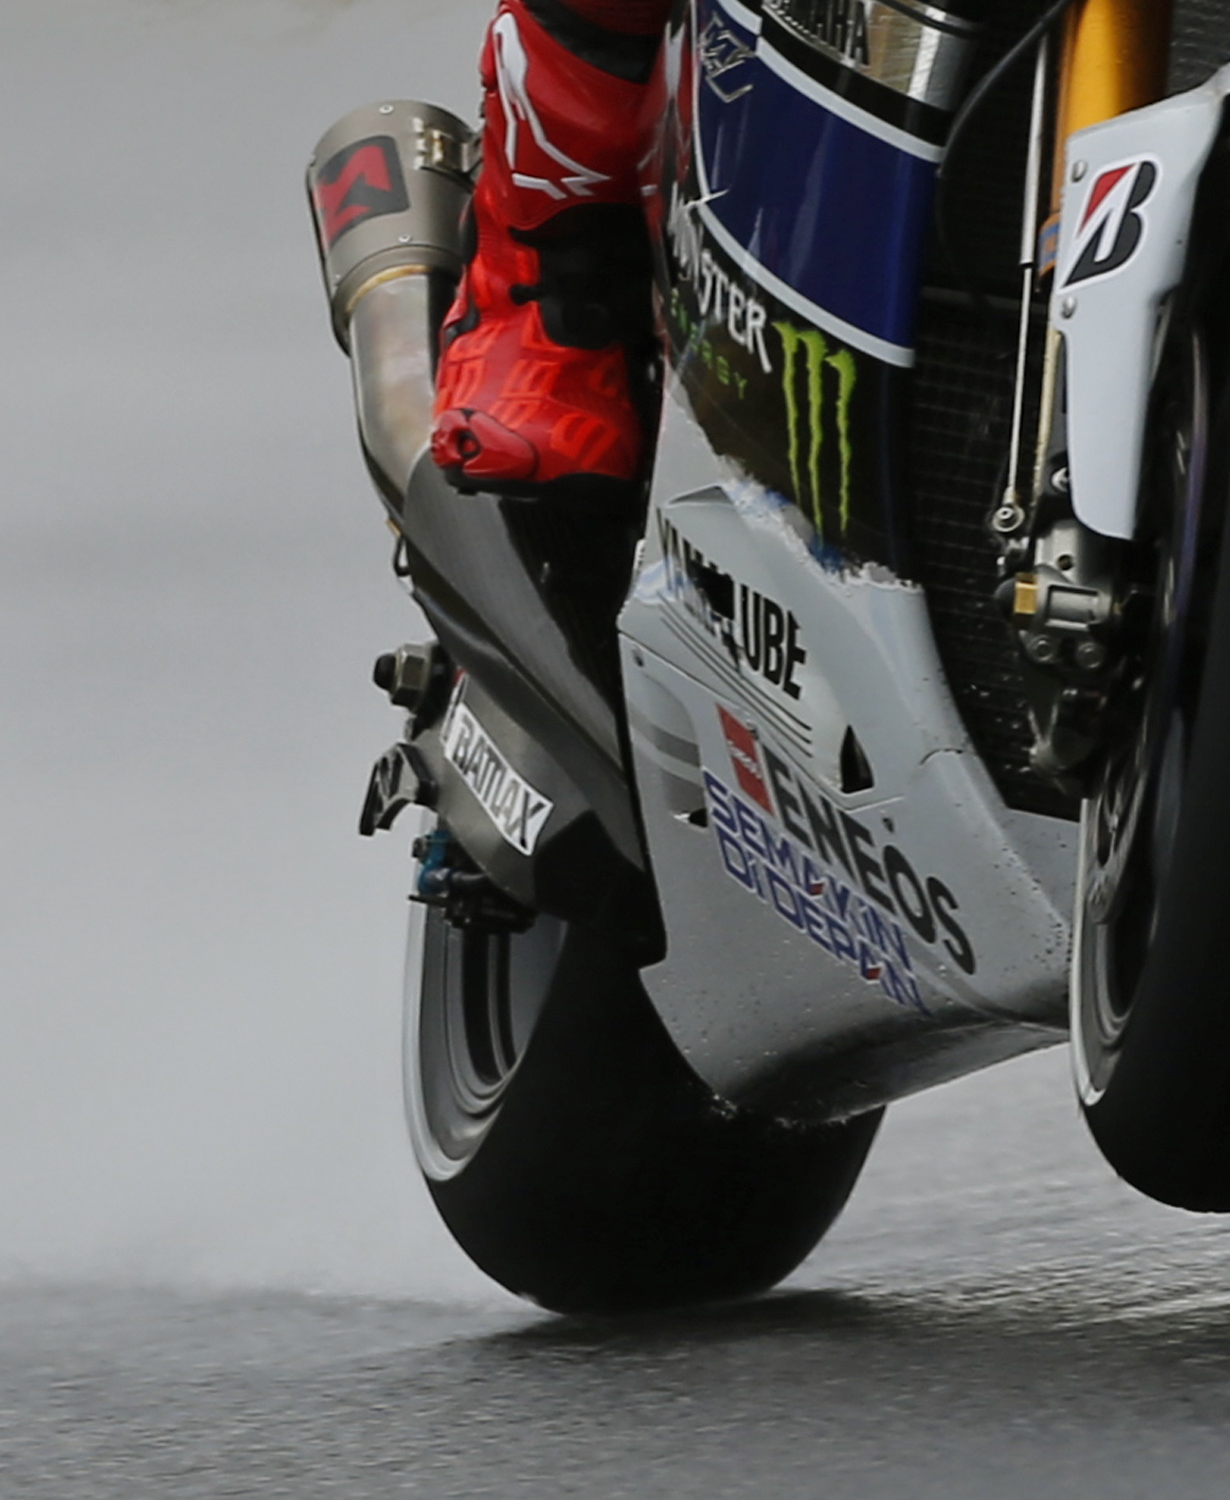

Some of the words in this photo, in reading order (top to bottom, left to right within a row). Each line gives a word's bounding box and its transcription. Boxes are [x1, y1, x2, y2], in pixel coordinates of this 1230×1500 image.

[656, 506, 807, 700] YAUBE
[761, 744, 977, 976] ENEOS
[767, 866, 934, 1018] DEPAN
